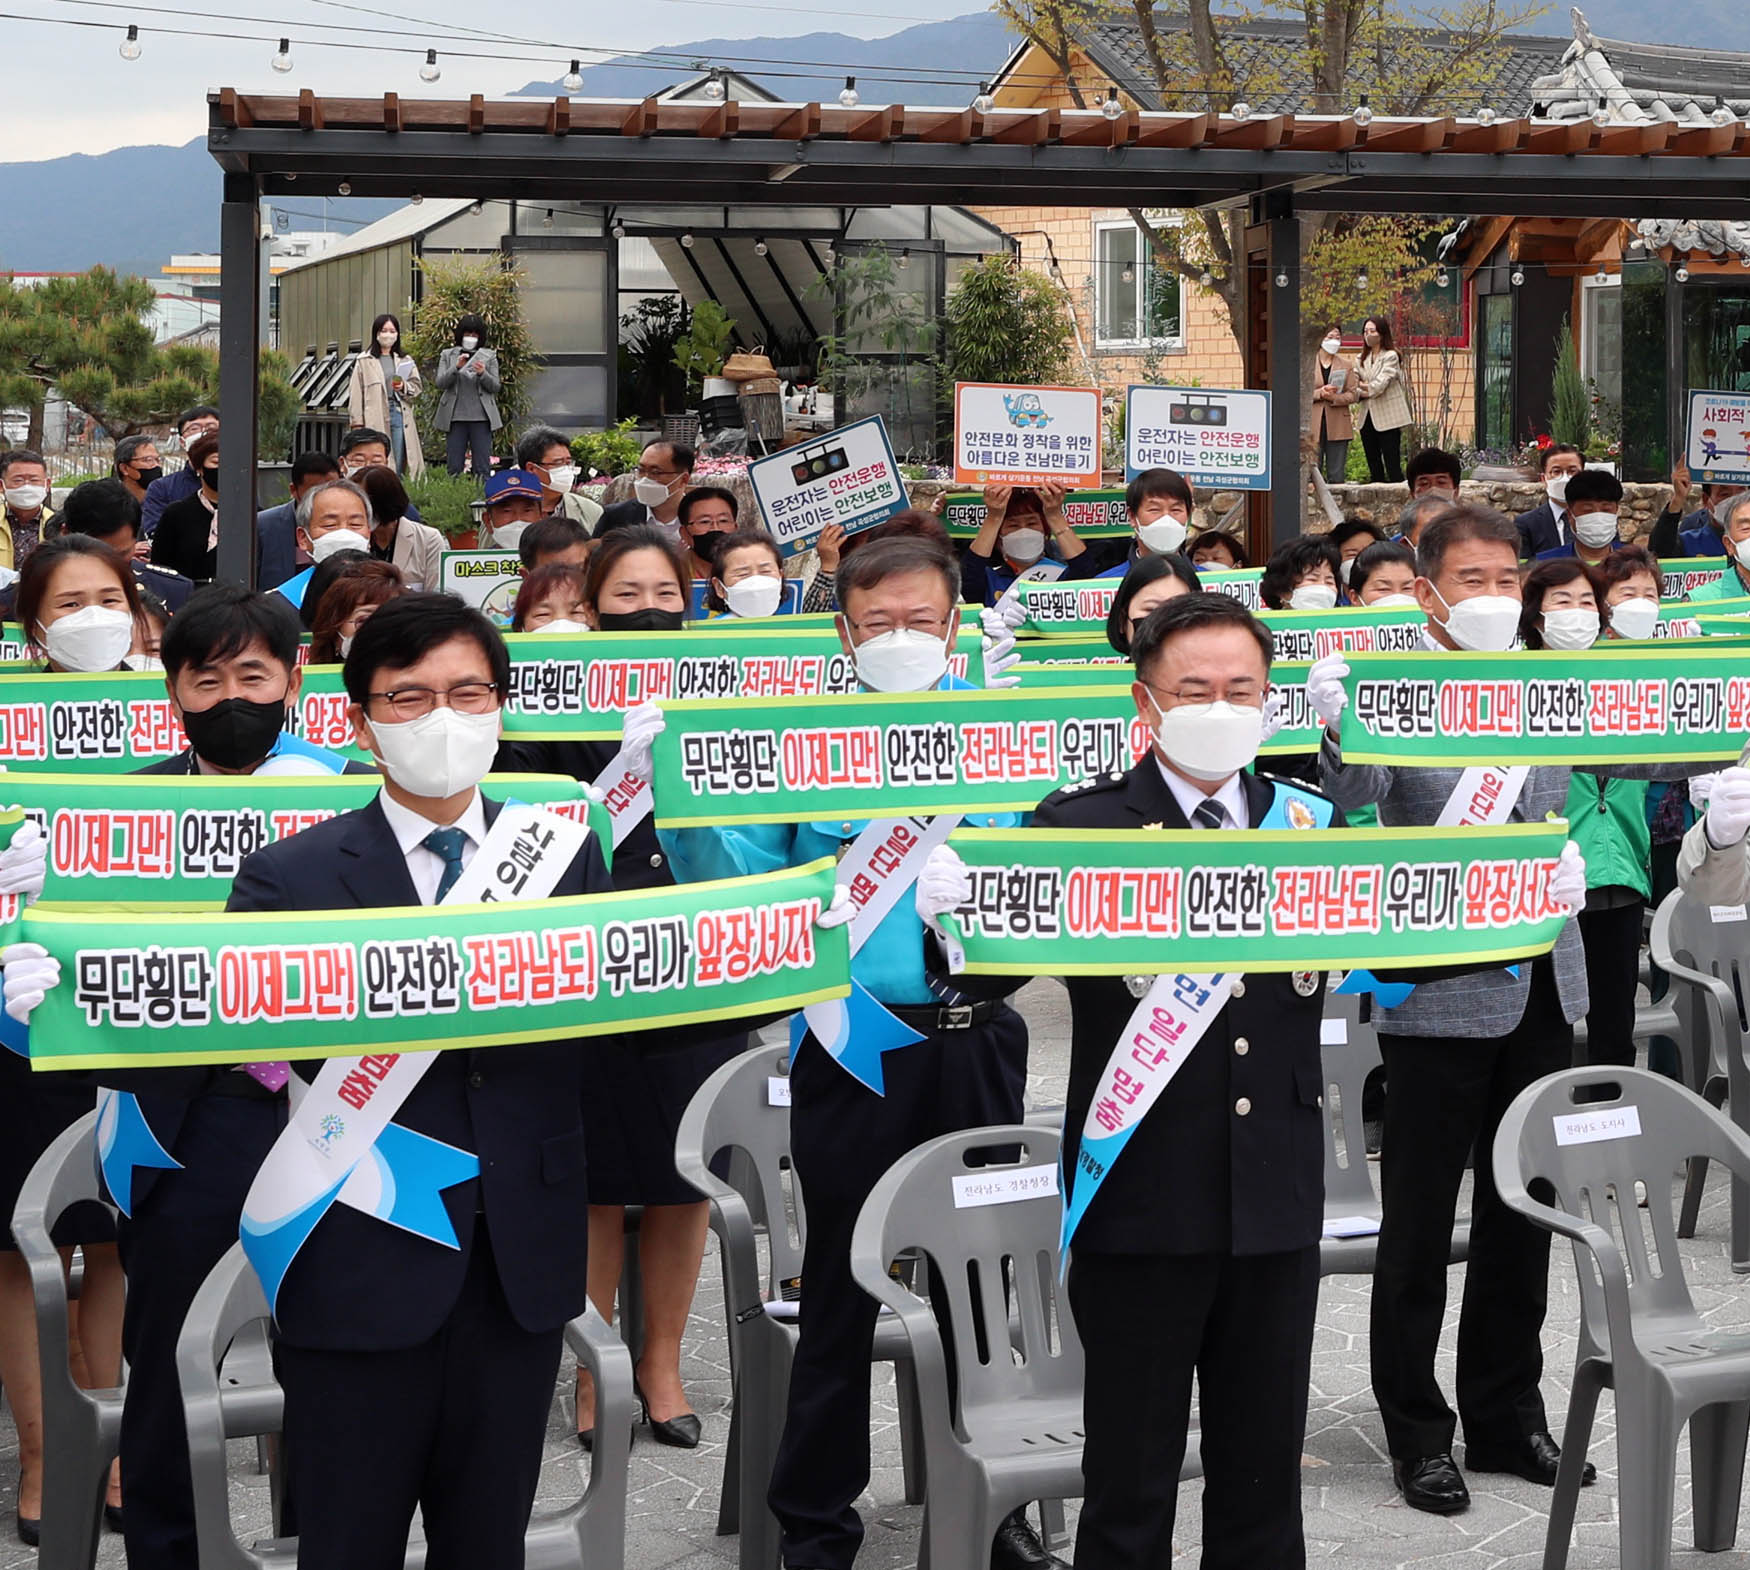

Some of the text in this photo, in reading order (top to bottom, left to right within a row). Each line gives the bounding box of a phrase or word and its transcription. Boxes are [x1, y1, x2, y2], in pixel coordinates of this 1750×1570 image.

[965, 432, 1092, 451] 안전문화 정착을 위한
[1138, 428, 1259, 448] 운전자는 안전운행
[1704, 408, 1744, 424] 사회적
[967, 450, 1090, 469] 아름다운 전남만들기
[1138, 448, 1260, 468] 어린이는 안전보행
[771, 462, 888, 517] 운전자는 안전운행
[778, 482, 894, 536] 어린이는 안전보행
[1066, 501, 1107, 525] 전라남도!
[455, 561, 499, 577] 마스크
[1029, 592, 1076, 620] 무단횡단
[507, 660, 583, 710] 무단횡단
[587, 658, 672, 707] 이제그만!
[1357, 683, 1435, 733] 무단횡단
[1440, 683, 1521, 732] 이제그만!
[1528, 682, 1583, 731] 안전한
[1589, 682, 1666, 731] 전라남도!
[1670, 681, 1722, 728] 우리가
[53, 703, 124, 754] 안전한
[684, 733, 776, 793] 무단횡단
[784, 730, 881, 787] 이제그만!
[888, 727, 955, 782] 안전한
[961, 722, 1056, 780] 전라남도!
[1062, 719, 1124, 775] 우리가
[1469, 772, 1504, 822] 일단
[56, 812, 173, 873] 이제그만!
[868, 825, 919, 879] 일단
[1067, 870, 1180, 932] 이제그만!
[1188, 870, 1266, 931] 안전한
[1272, 868, 1380, 931] 전라남도!
[1387, 866, 1459, 927] 우리가
[79, 903, 818, 1022] 무단횡단 이제그만! 안전한 전라남도! 우리가 앞장서자!
